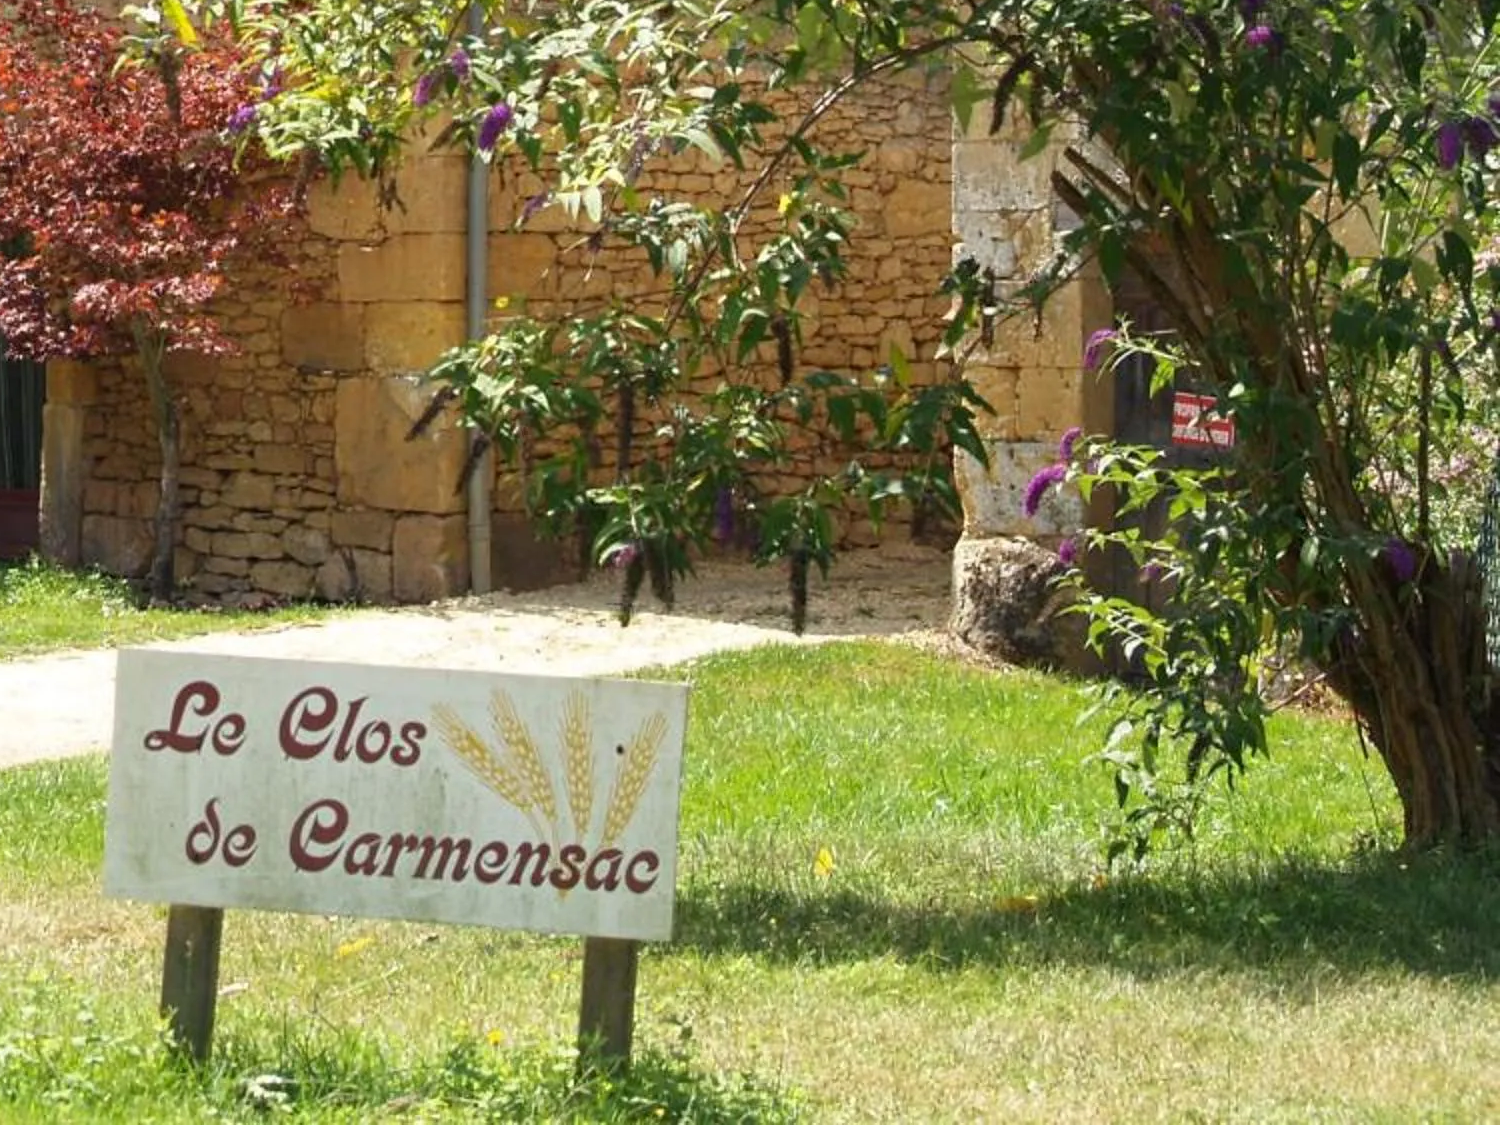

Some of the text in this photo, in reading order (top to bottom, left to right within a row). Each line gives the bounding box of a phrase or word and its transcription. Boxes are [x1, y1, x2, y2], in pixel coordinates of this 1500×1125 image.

[143, 680, 428, 766] Le Clos
[185, 797, 660, 894] de Carmensac
